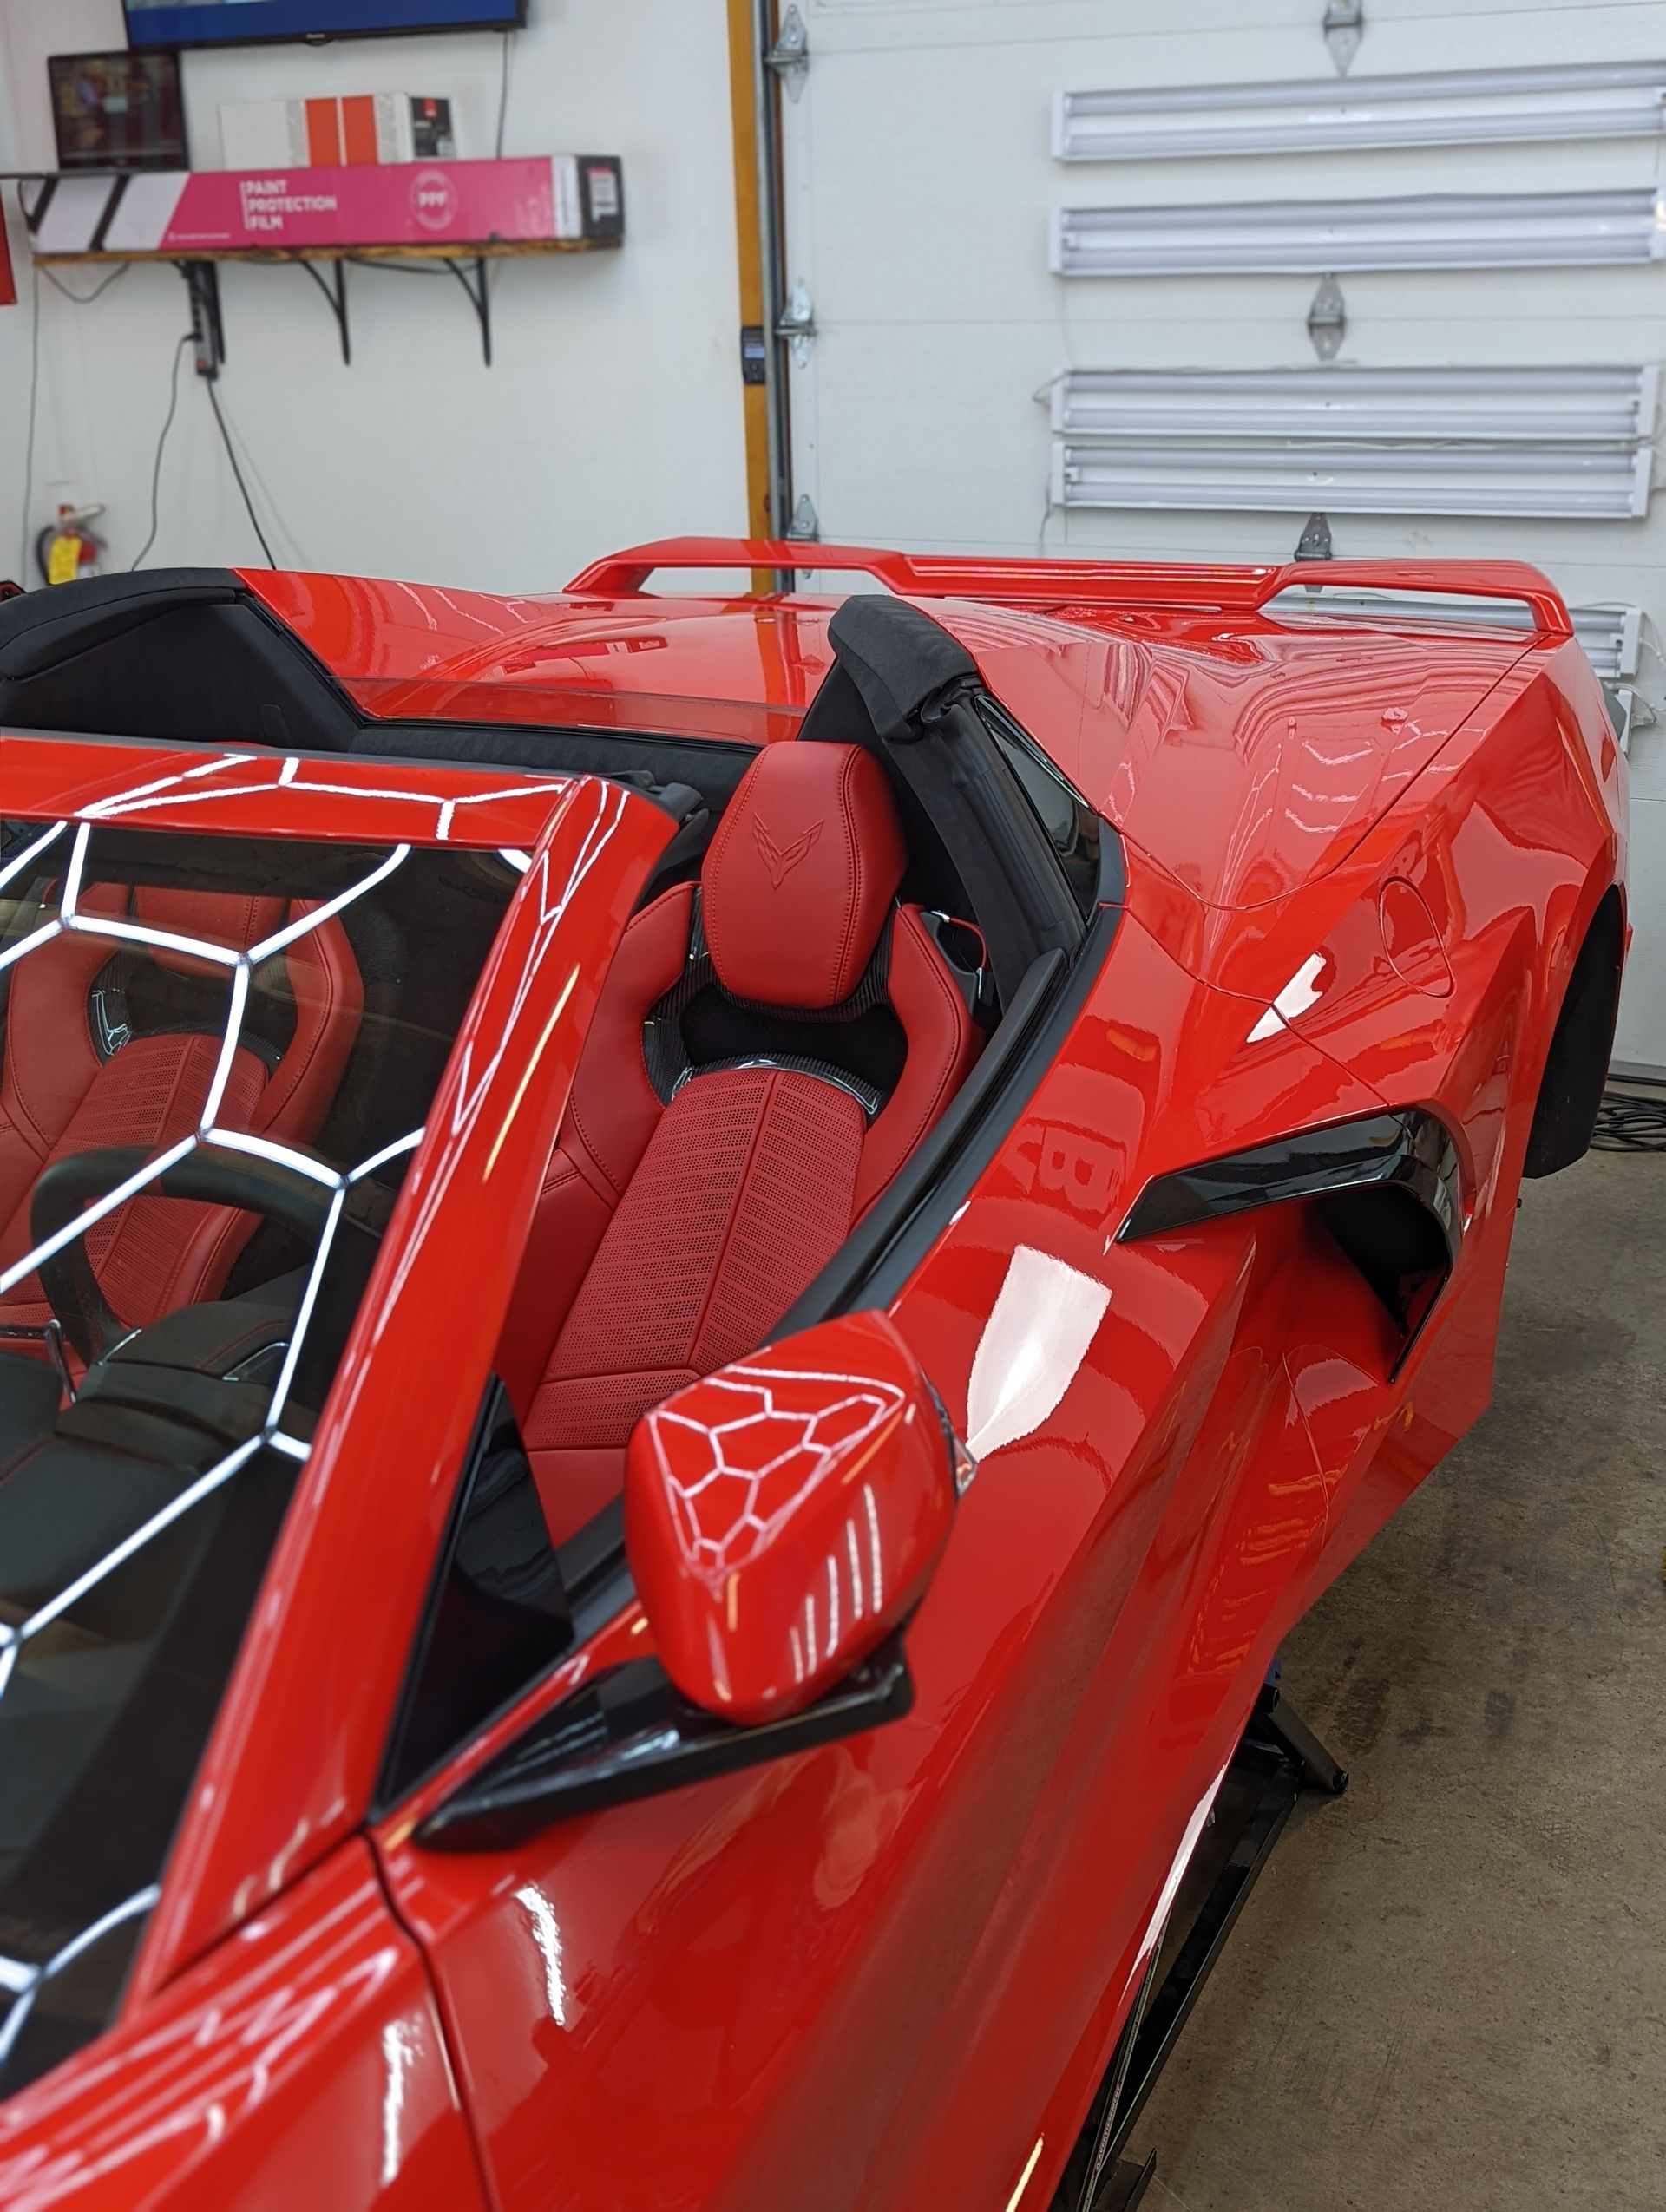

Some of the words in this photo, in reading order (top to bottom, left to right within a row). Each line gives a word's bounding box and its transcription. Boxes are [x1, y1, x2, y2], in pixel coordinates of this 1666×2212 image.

[245, 179, 288, 195] PAINT
[247, 195, 338, 213] PROTECTION
[418, 191, 449, 208] PPF
[249, 215, 285, 232] FILM
